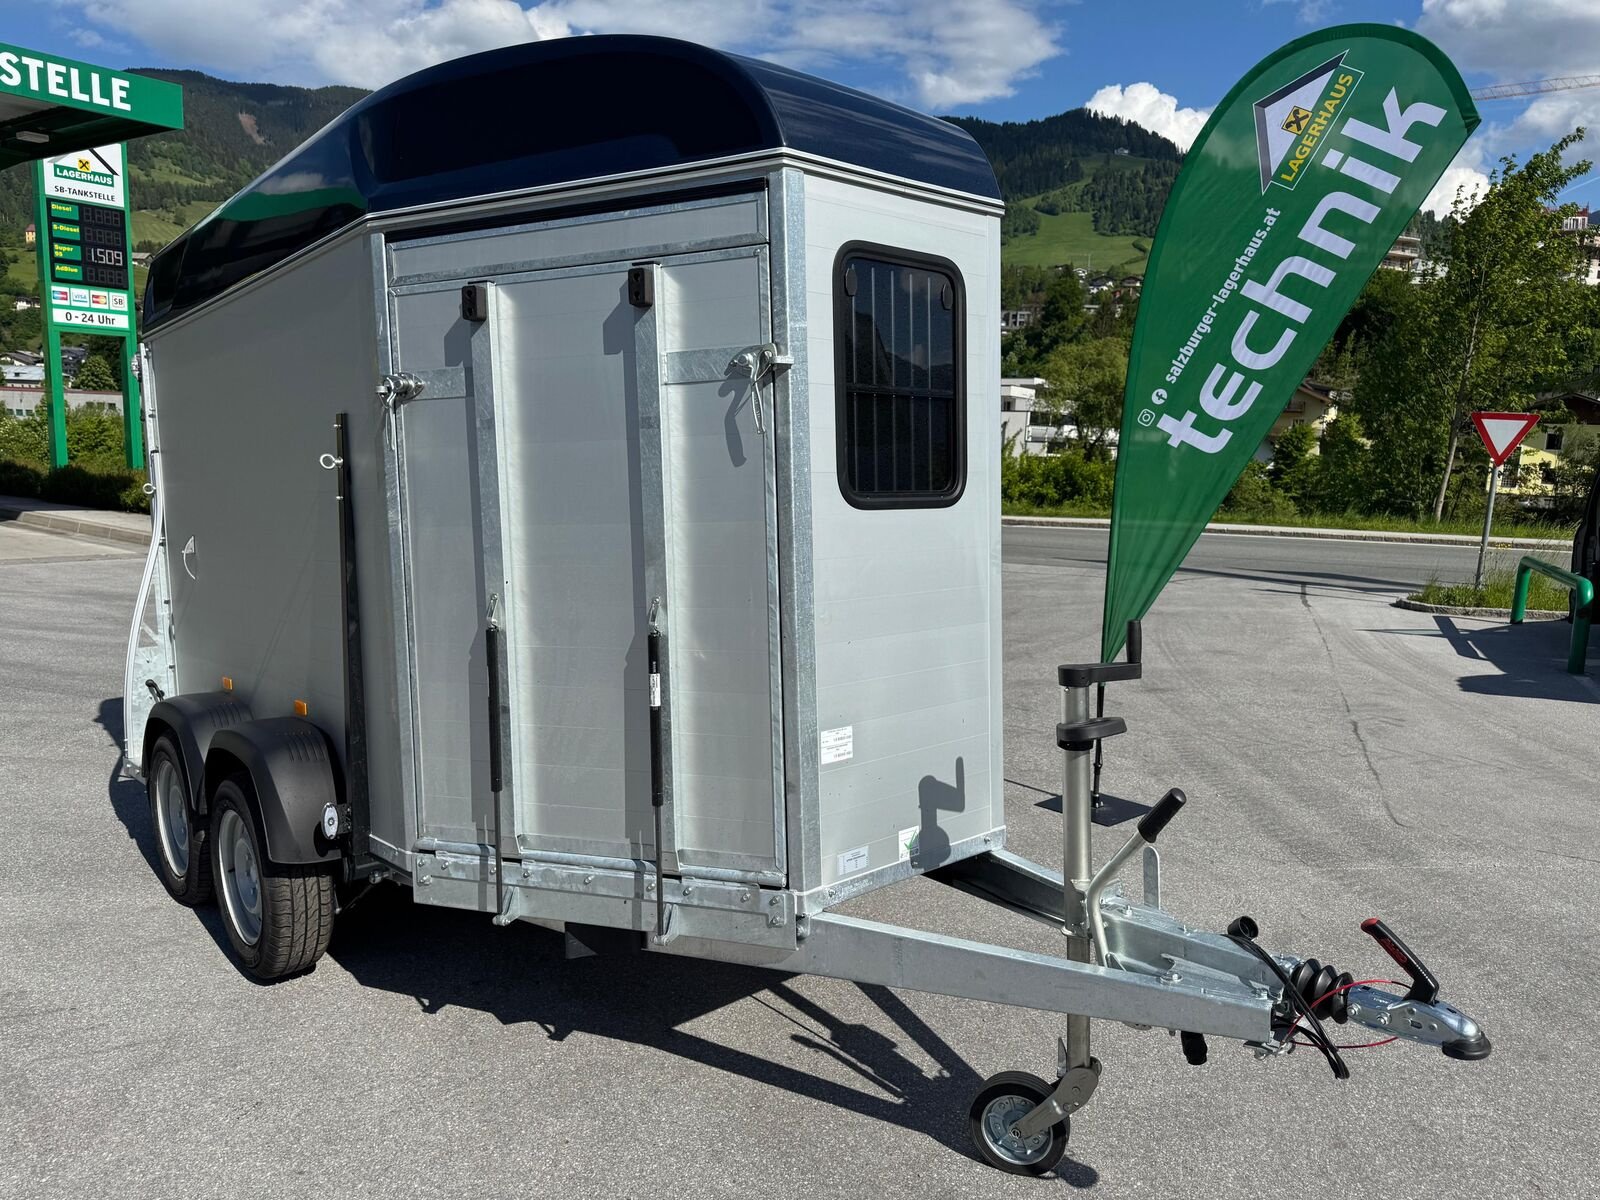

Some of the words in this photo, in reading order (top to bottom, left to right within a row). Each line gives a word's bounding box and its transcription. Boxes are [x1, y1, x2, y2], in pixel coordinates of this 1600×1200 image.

[0, 52, 131, 111] STELLE
[1280, 73, 1354, 182] LAGERHAUS
[56, 167, 113, 185] LAGERHAUS
[54, 185, 116, 202] SB-TANKSTELLE
[51, 203, 72, 212] Diesel
[54, 244, 74, 252] Super
[91, 247, 123, 266] 1.509
[55, 265, 78, 273] AdBlue
[1156, 86, 1448, 454] technik
[113, 298, 123, 306] SB
[1165, 207, 1281, 384] salzburger-lagerhaus.at
[65, 311, 72, 321] 0
[81, 313, 94, 323] 24
[98, 315, 115, 325] Uhr
